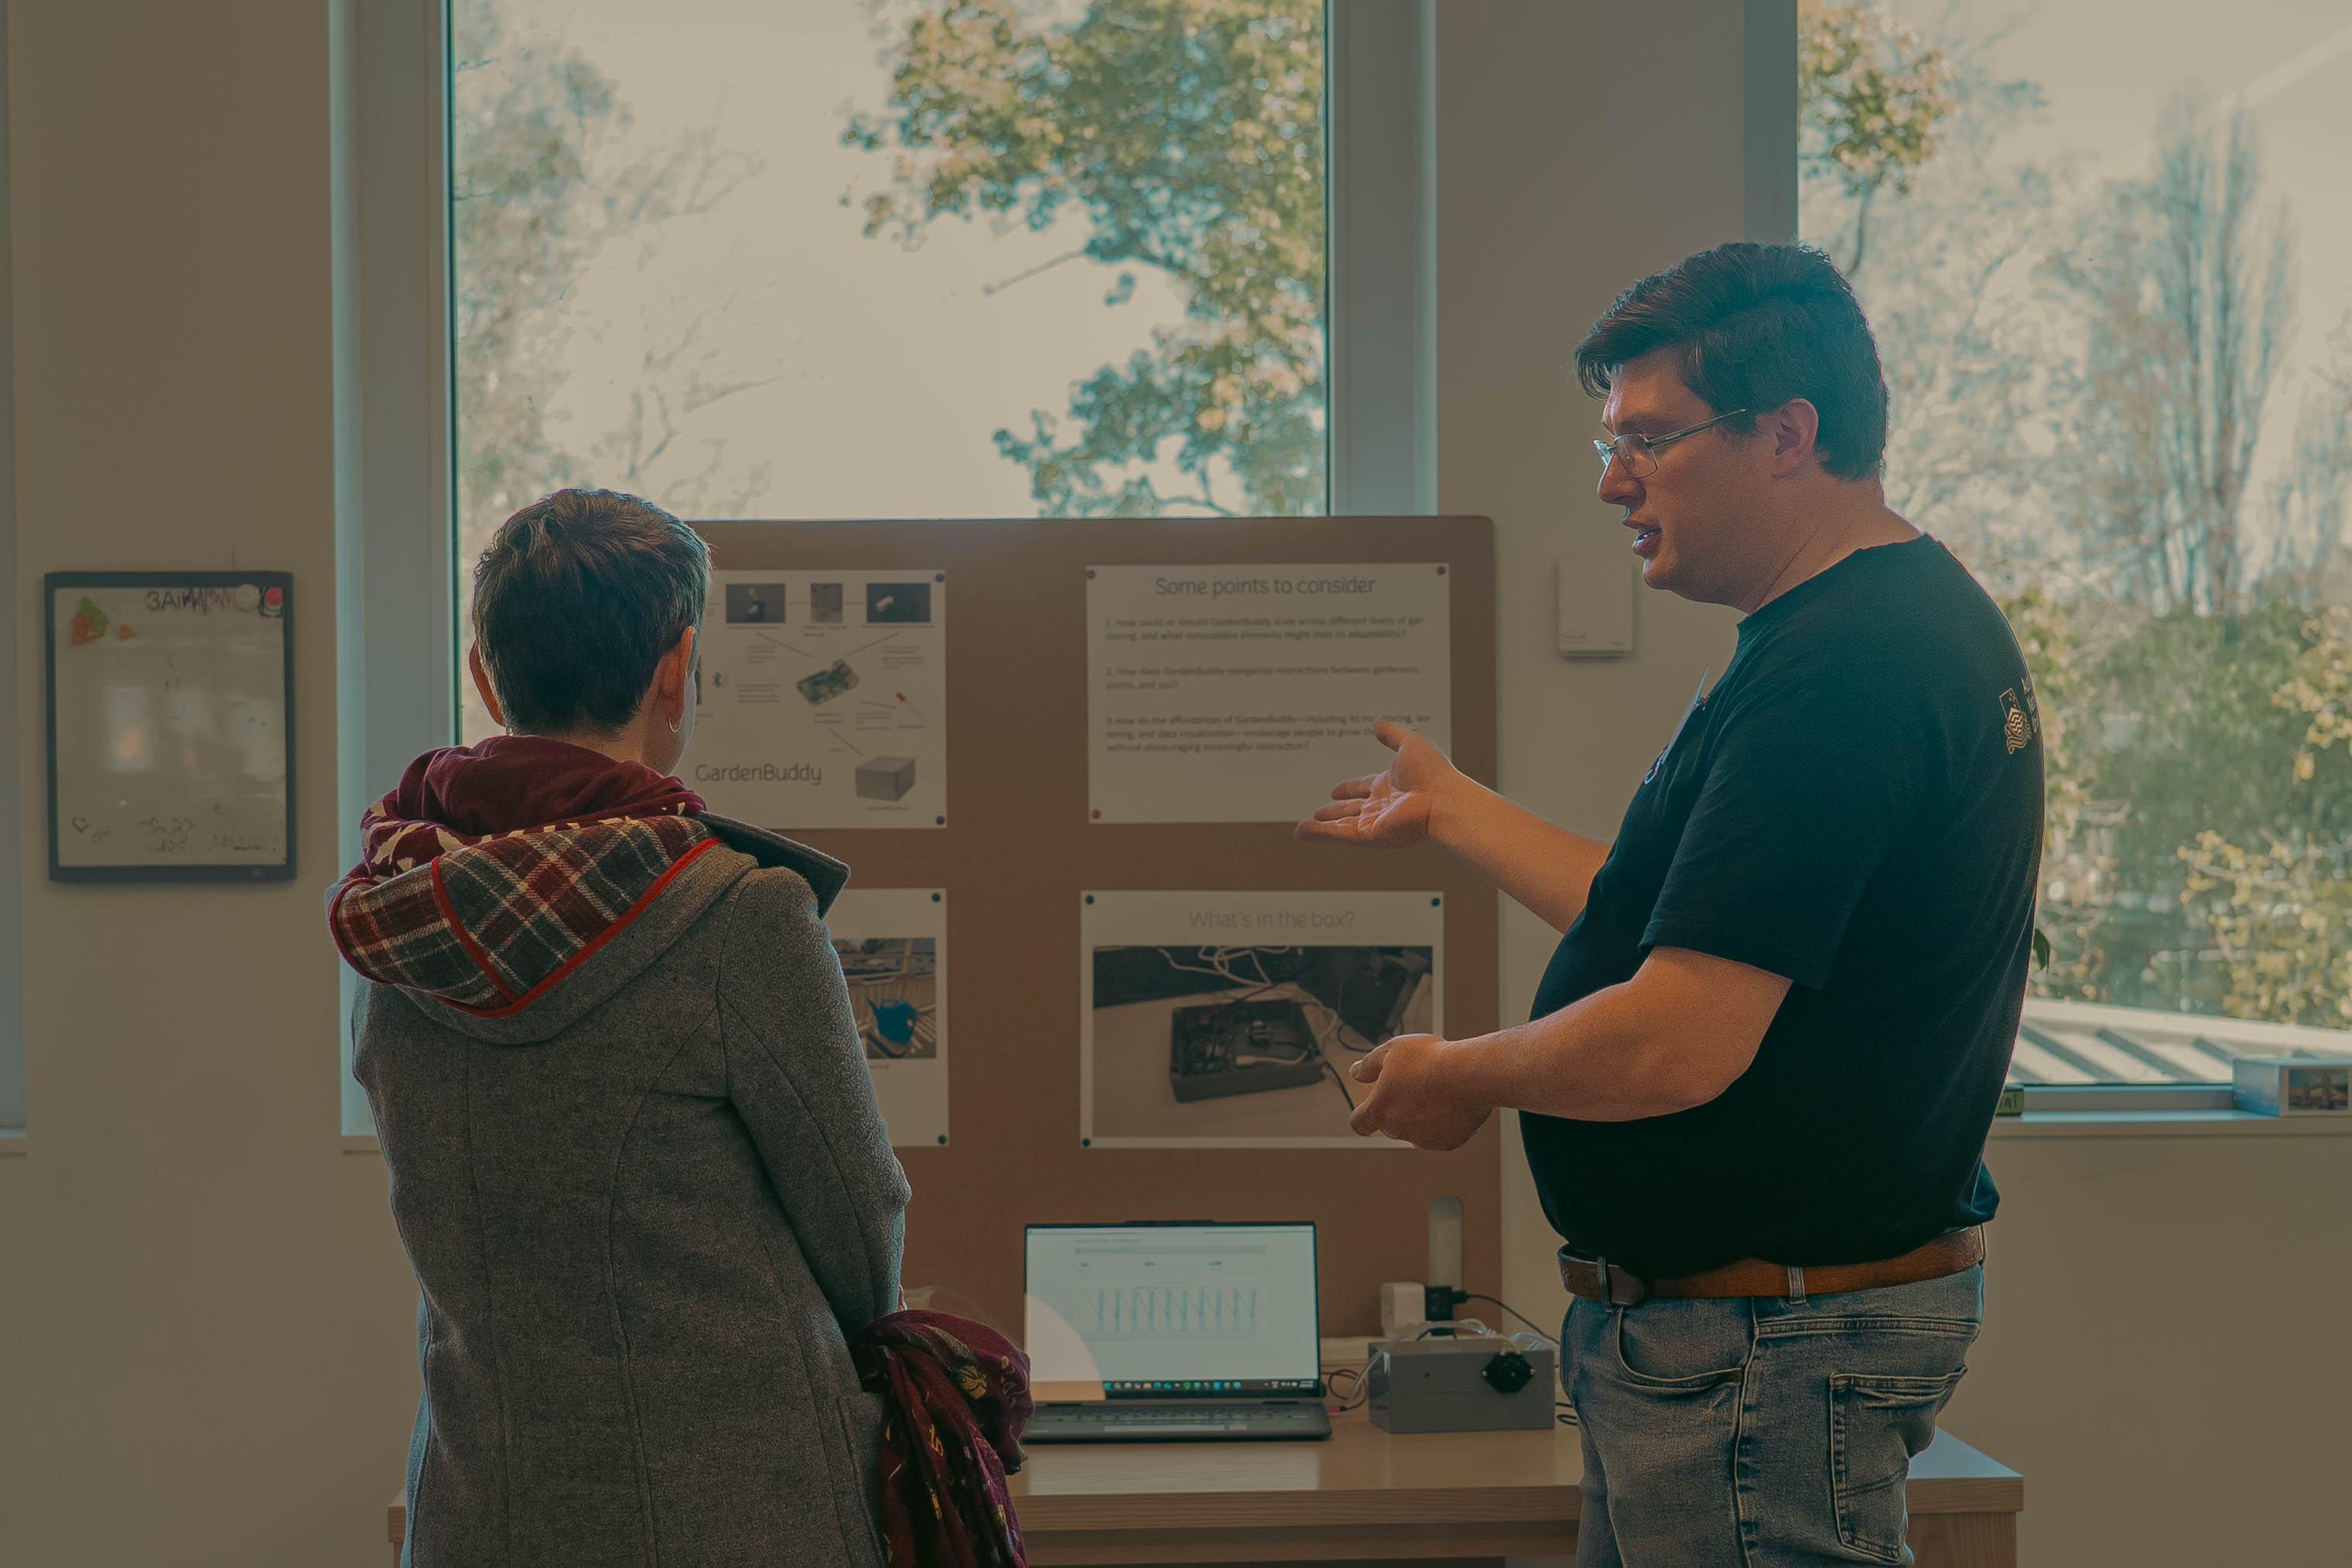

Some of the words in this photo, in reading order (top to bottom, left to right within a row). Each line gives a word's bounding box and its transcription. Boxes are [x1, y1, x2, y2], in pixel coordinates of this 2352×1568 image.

[1155, 576, 1208, 595] Some
[1212, 578, 1270, 600] points
[1275, 579, 1293, 594] to
[1297, 576, 1377, 594] consider
[695, 764, 822, 787] GardenBuddy
[1188, 910, 1252, 928] What's
[1256, 910, 1274, 927] in
[1277, 910, 1306, 927] the
[1311, 910, 1355, 928] box?
